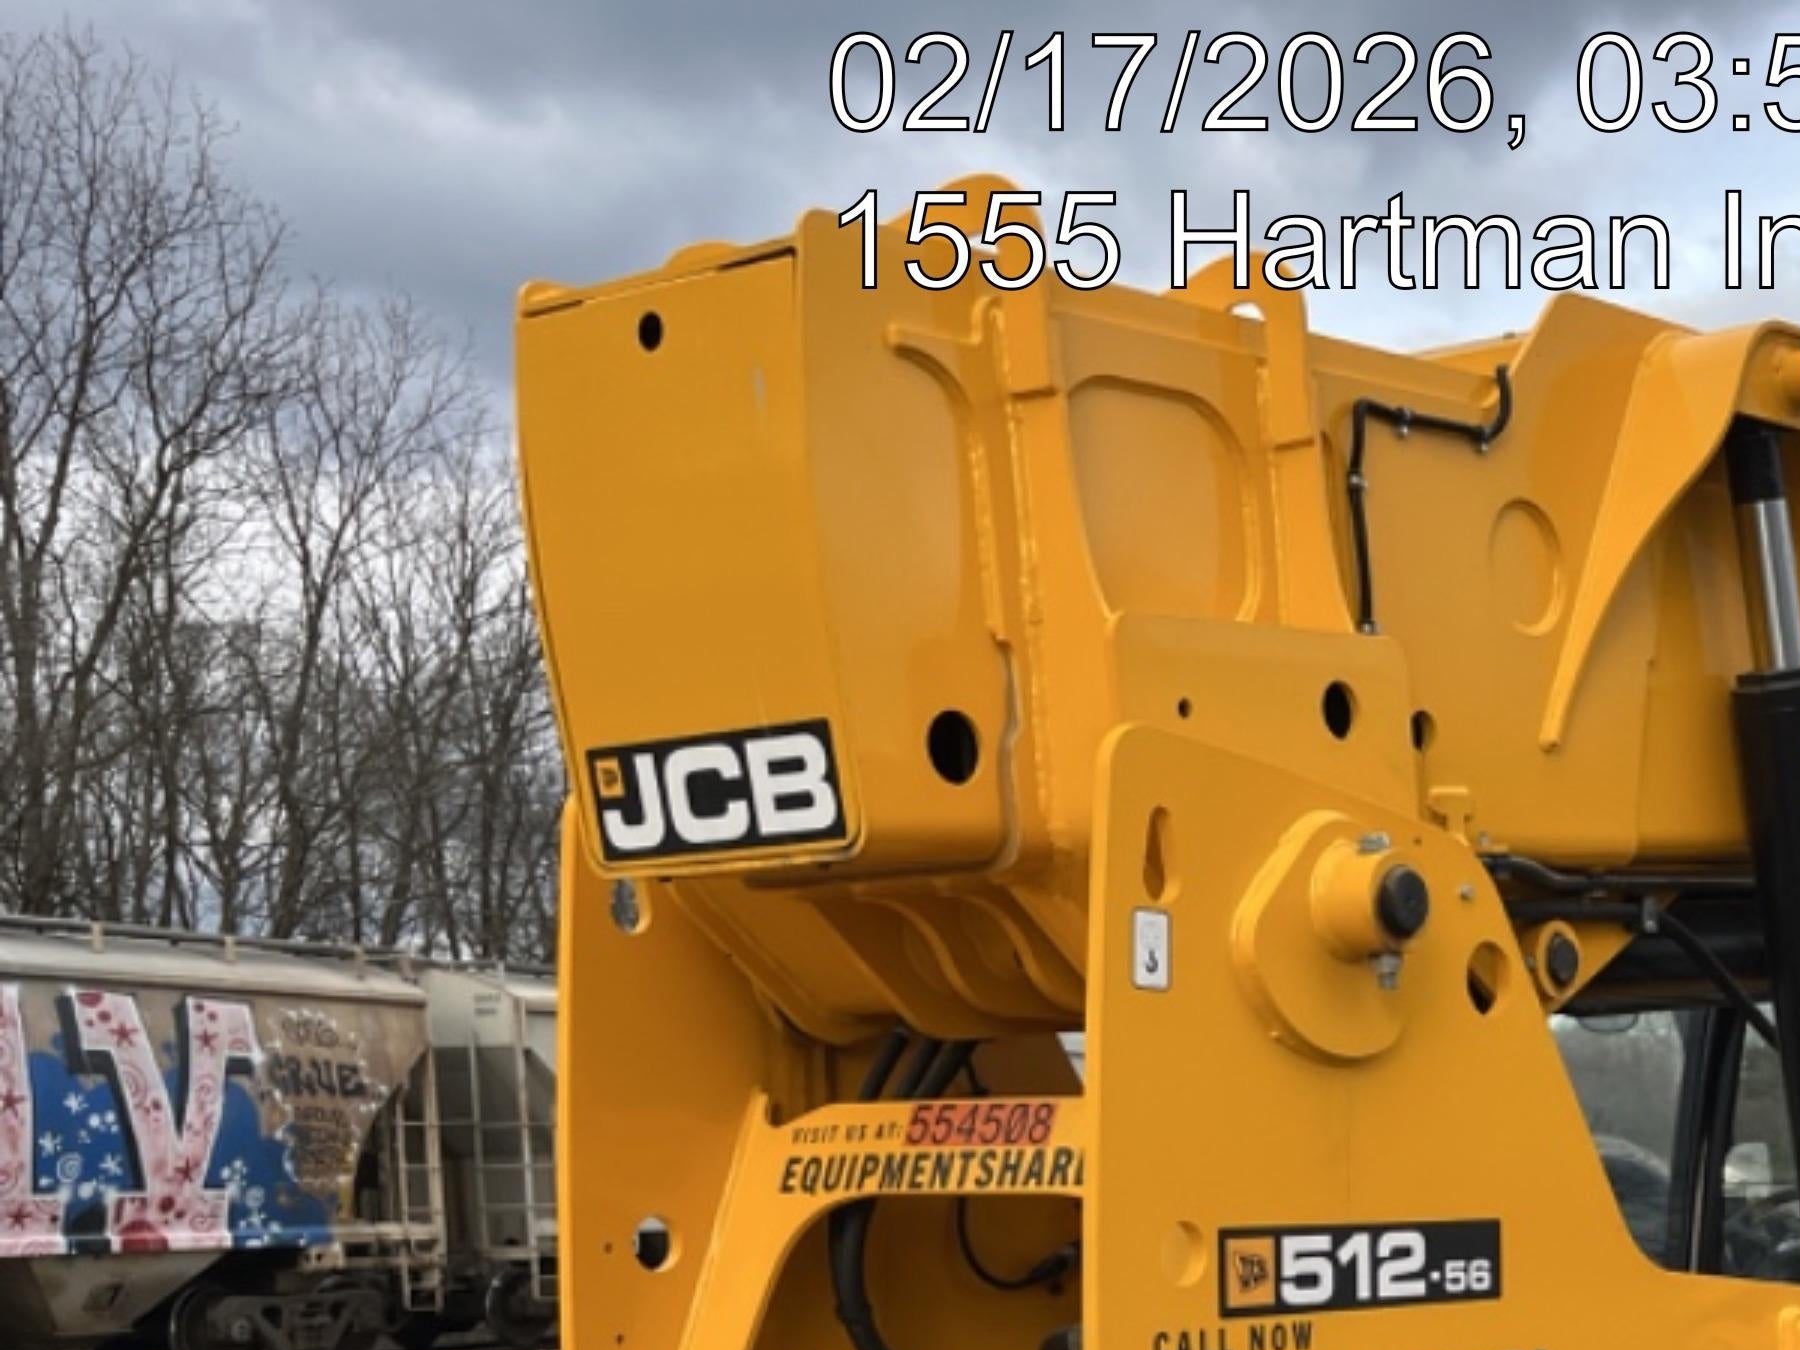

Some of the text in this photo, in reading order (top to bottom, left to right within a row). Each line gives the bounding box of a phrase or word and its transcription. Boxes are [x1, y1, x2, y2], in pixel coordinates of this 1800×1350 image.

[602, 733, 837, 851] JCB
[791, 1123, 839, 1145] VISIT
[844, 1122, 867, 1142] US
[906, 1101, 1056, 1145] 554508
